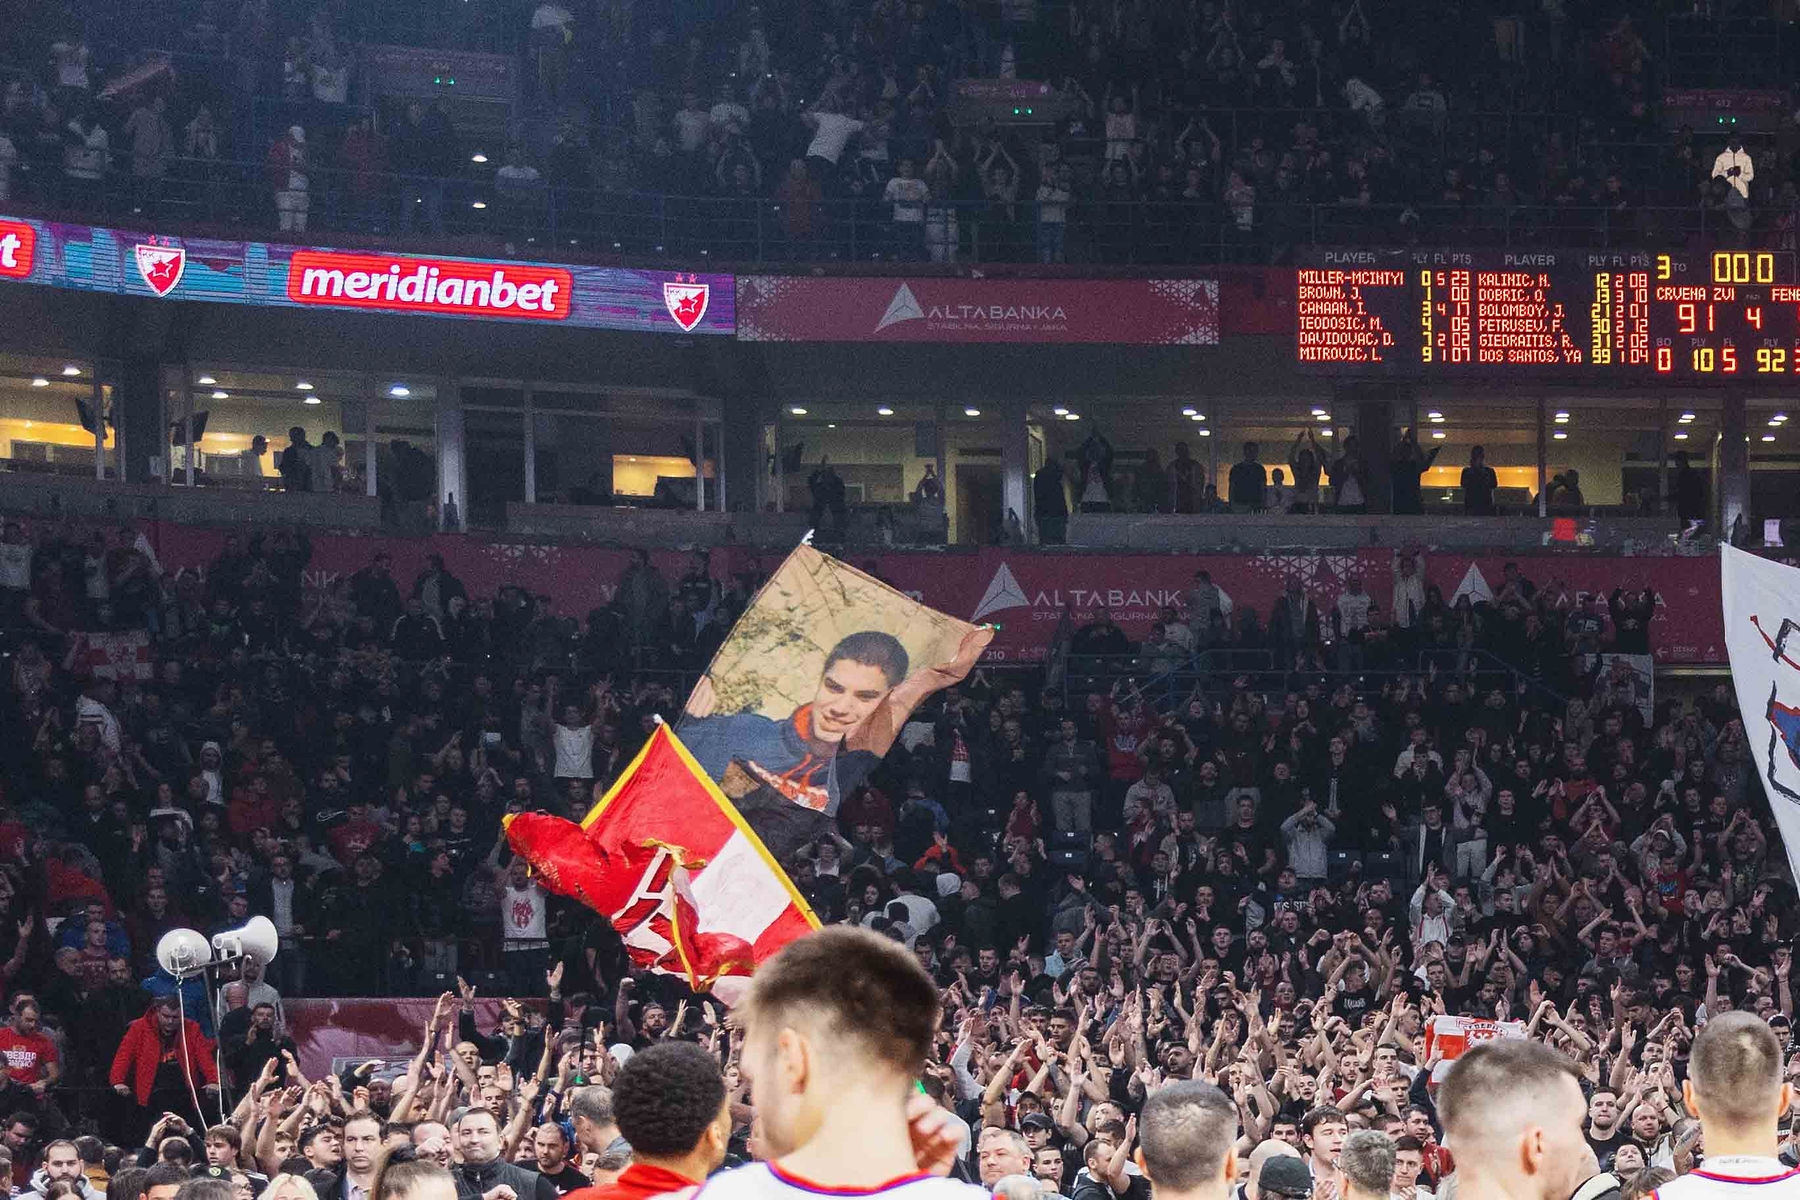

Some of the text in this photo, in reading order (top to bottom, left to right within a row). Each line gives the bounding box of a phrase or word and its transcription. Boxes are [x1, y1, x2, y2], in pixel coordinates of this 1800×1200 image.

[1325, 252, 1376, 263] PLAYER
[1505, 255, 1556, 266] PLAYER
[1658, 256, 1670, 279] 3
[1451, 271, 1469, 285] 23
[1479, 273, 1647, 288] KALINIC, N. 12 08
[302, 265, 558, 310] meridianbet
[1300, 286, 1345, 299] BROWN,
[1351, 287, 1361, 300] J.
[1657, 287, 1705, 300] CRVENA
[1479, 288, 1529, 301] DOBRIC,
[1597, 289, 1609, 303] 13
[1636, 289, 1647, 303] 10
[929, 305, 1067, 320] ALTABANKA
[1300, 301, 1469, 316] CANAAN, I. 17
[1479, 303, 1647, 318] BOLOMBOY, J. 21 01
[1300, 317, 1469, 331] TEODOSIC, M. 05
[1679, 304, 1713, 332] 91
[1747, 308, 1760, 329] 4
[1479, 319, 1647, 333] PETRUSEV, F. 30 12
[1300, 332, 1378, 345] DAVIDOVAC,
[1452, 331, 1470, 346] 02
[1480, 334, 1648, 348] GIEDRAITIS, R. 31 02
[1300, 347, 1470, 362] MITROVIC, L. 07
[1480, 349, 1648, 363] DOS SANTOS, YA 99 04
[1658, 348, 1671, 371] 0
[1694, 349, 1713, 371] 10
[1722, 349, 1736, 372] 5
[1757, 349, 1785, 372] 92
[1033, 590, 1188, 606] ALTABANK
[987, 651, 1005, 660] 210
